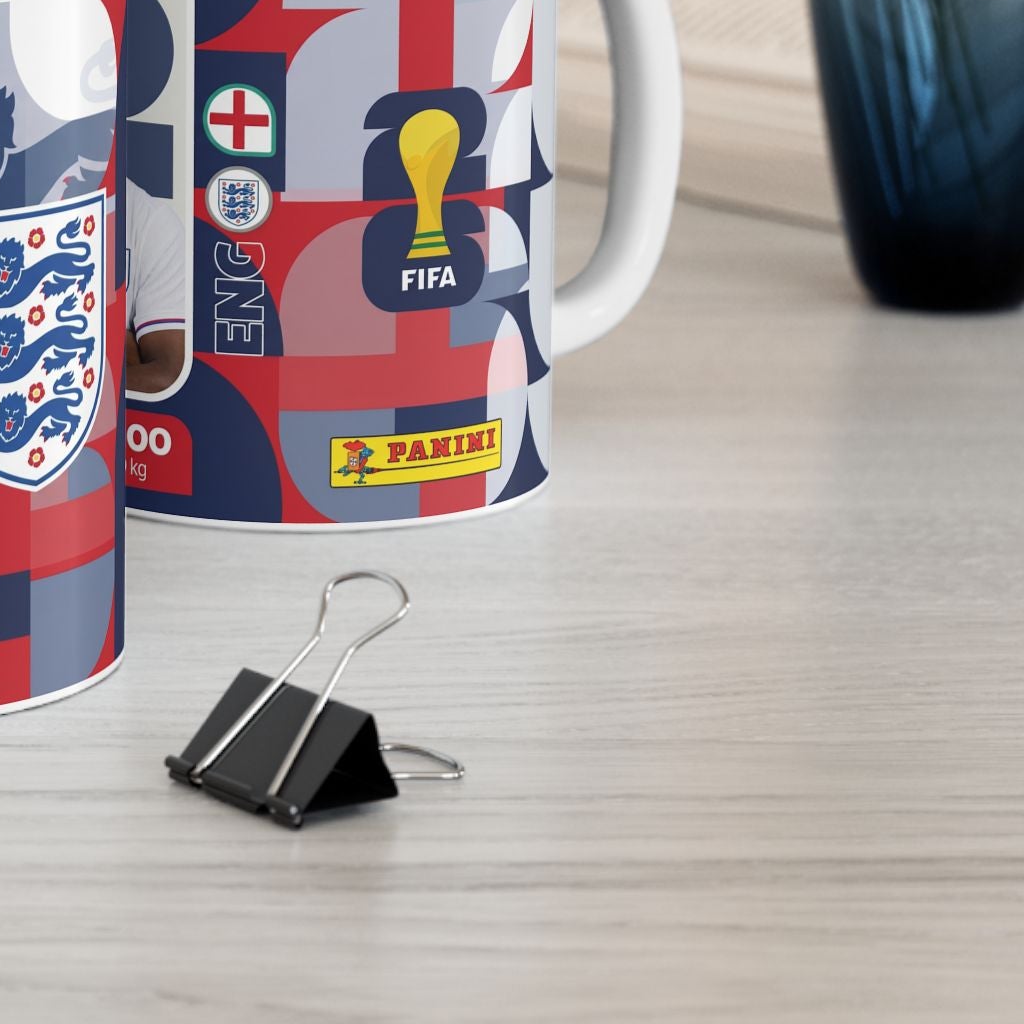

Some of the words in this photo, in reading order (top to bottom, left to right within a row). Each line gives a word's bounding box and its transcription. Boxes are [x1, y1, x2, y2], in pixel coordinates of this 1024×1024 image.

[401, 265, 457, 292] FIFA
[214, 241, 266, 357] ENG
[387, 427, 496, 463] PANINI
[130, 456, 147, 482] kg
